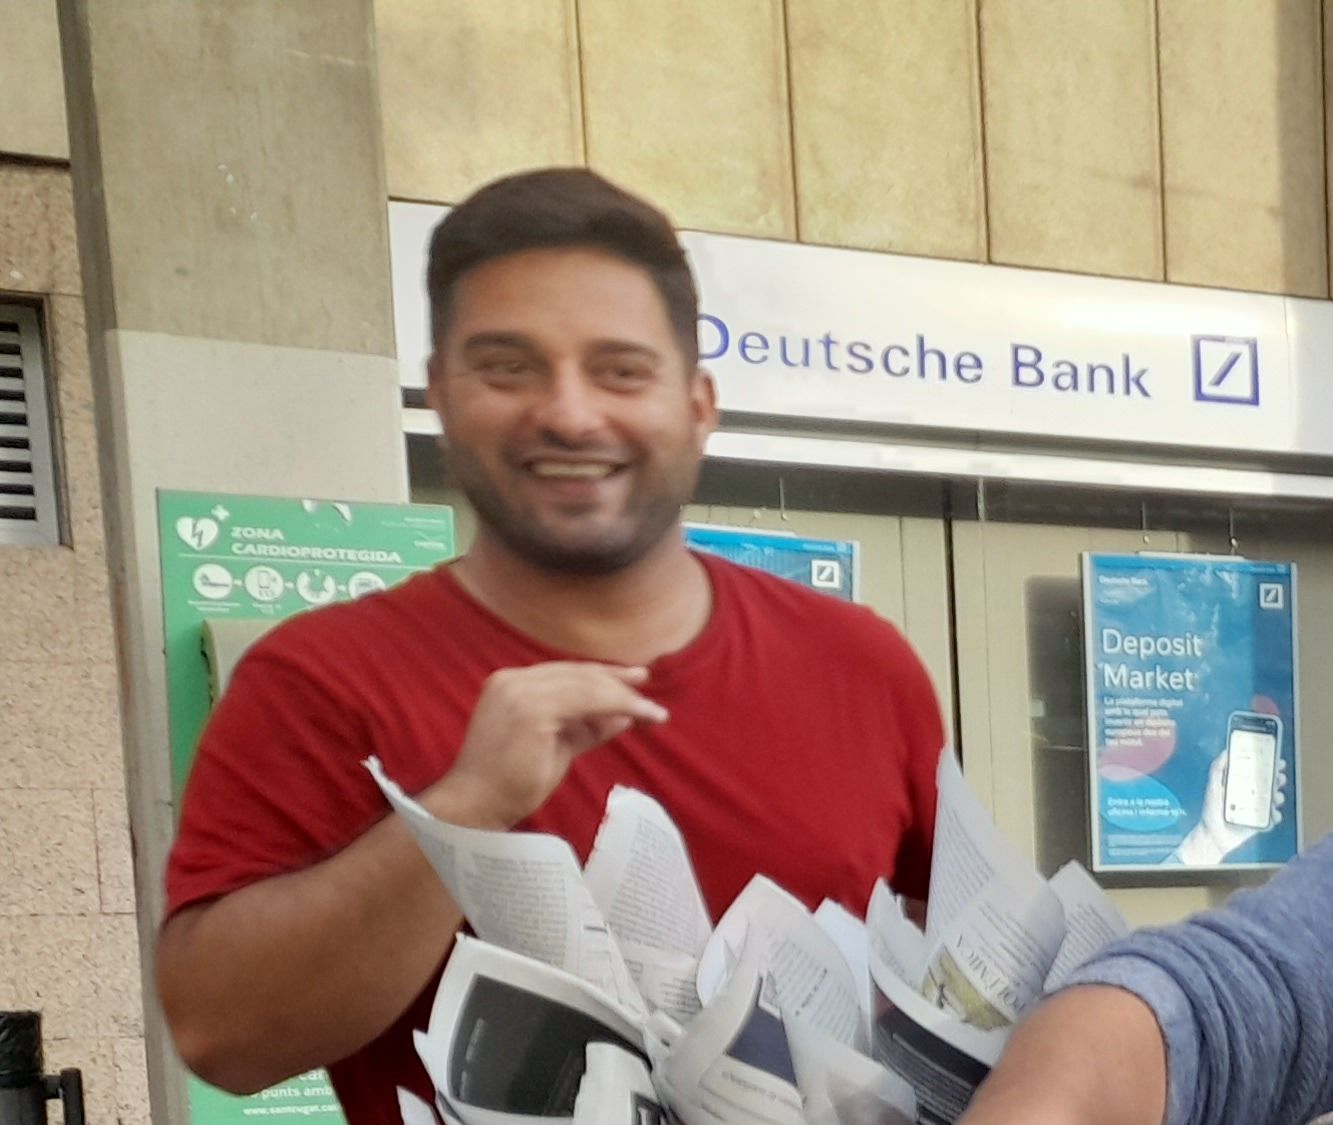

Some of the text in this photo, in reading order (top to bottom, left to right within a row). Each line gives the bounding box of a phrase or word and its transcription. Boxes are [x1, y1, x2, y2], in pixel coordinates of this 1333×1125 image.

[697, 313, 1152, 399] Deutsche Bank
[230, 525, 285, 541] ZONA
[230, 541, 402, 564] CARDIOPROTEGIDA
[1102, 627, 1202, 660] Deposit
[1103, 662, 1194, 692] Market
[261, 1086, 300, 1101] punts
